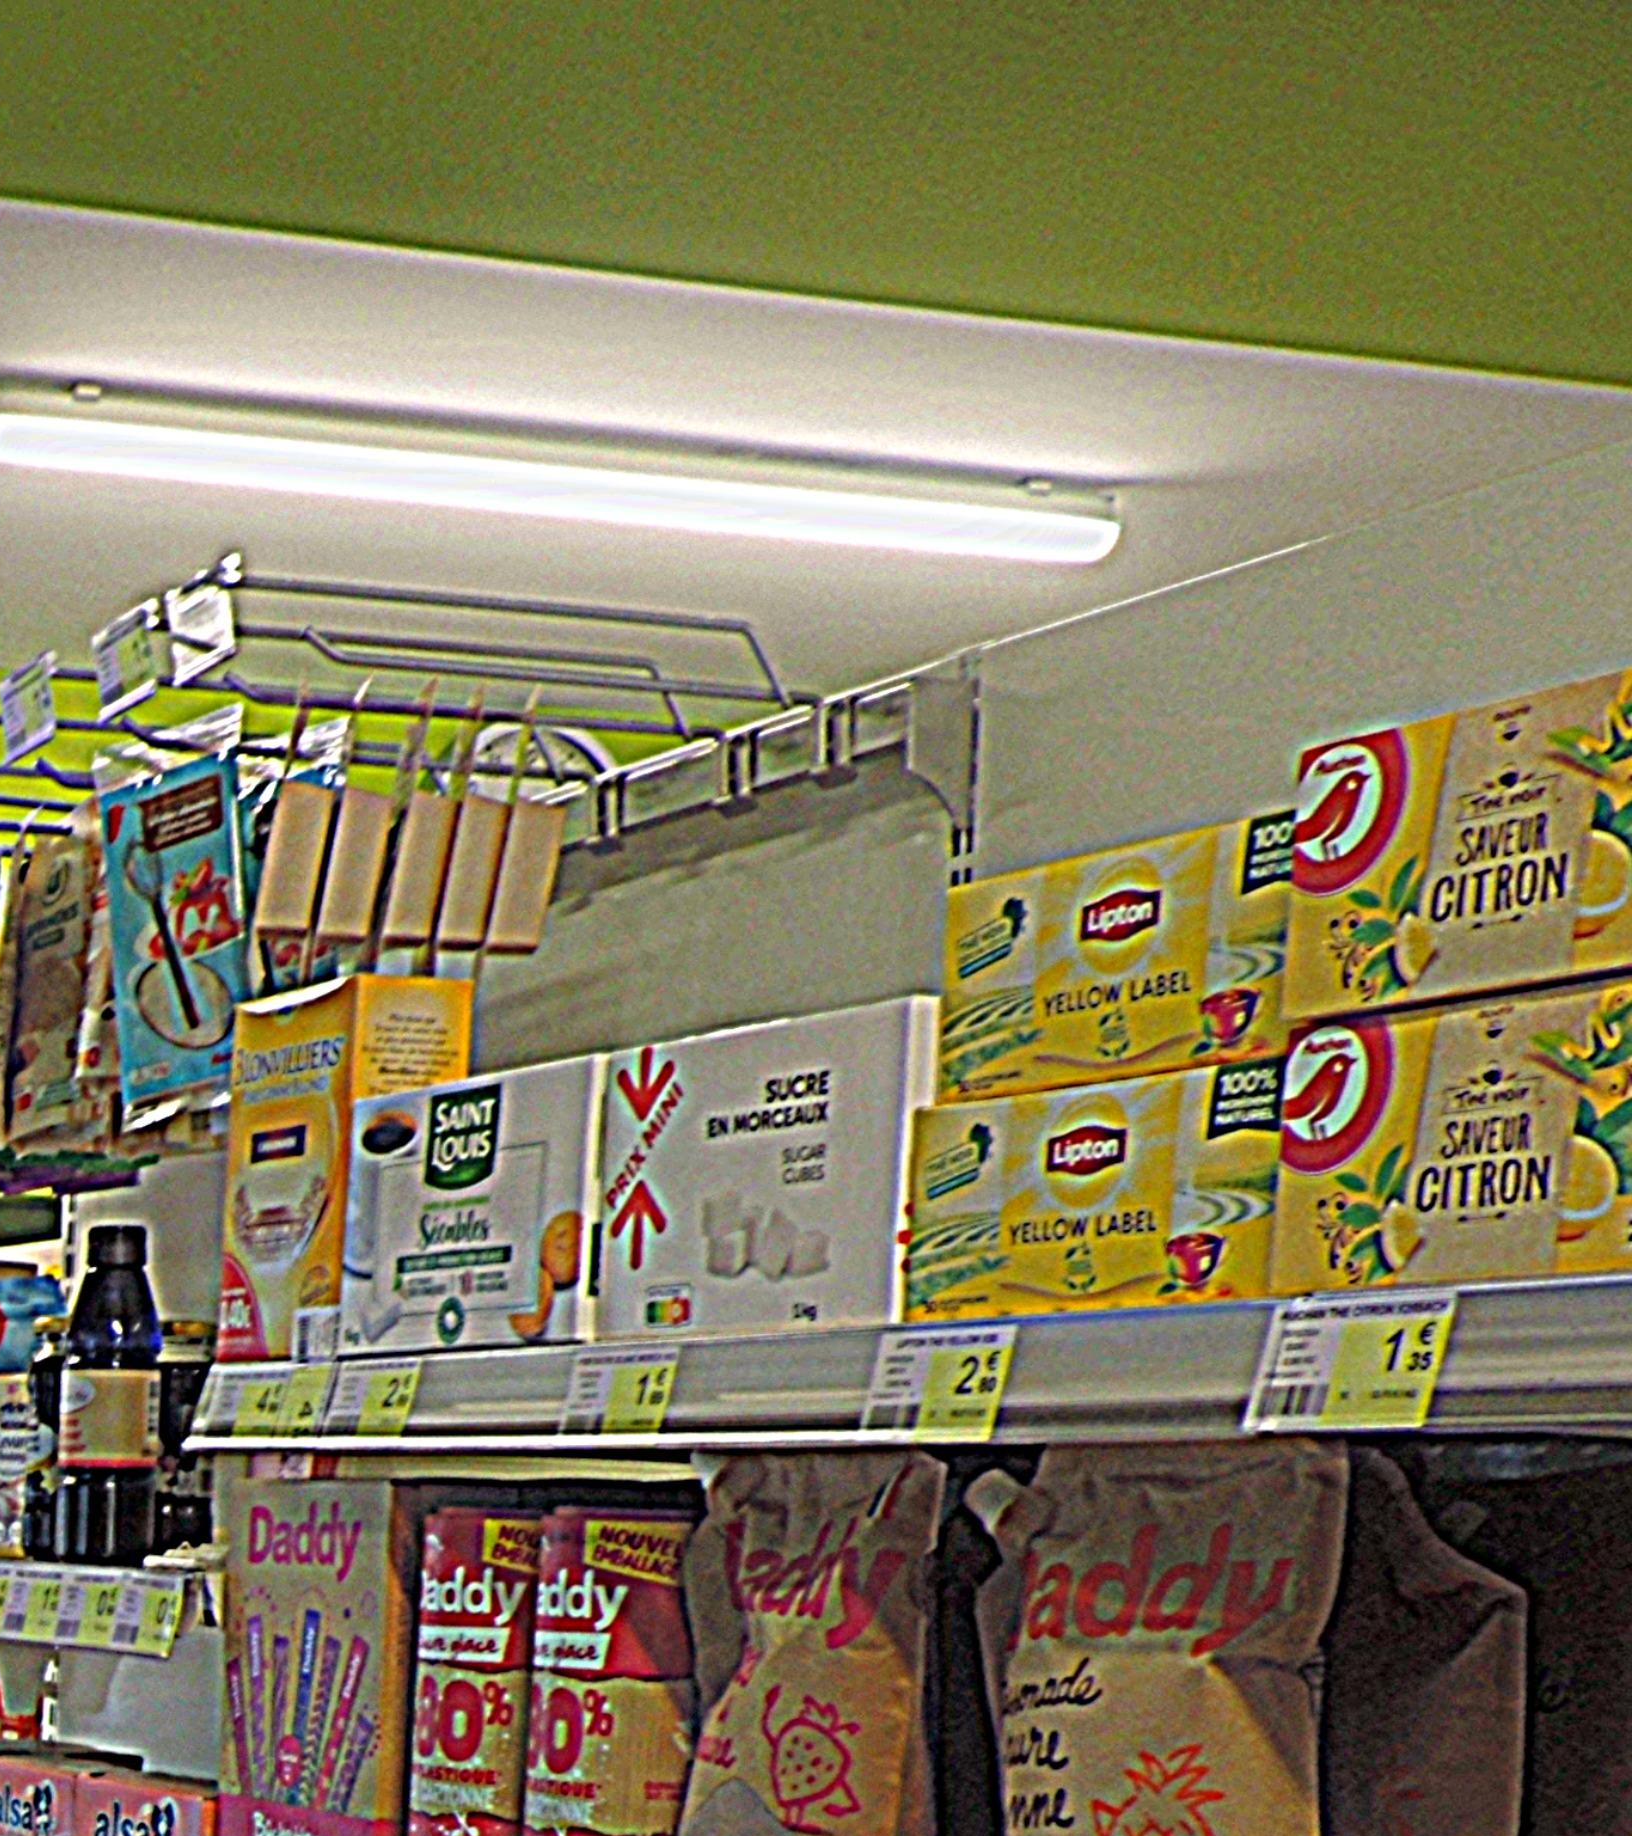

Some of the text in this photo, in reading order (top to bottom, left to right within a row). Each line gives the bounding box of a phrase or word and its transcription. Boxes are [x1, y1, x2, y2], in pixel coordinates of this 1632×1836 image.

[1253, 822, 1293, 848] 100
[1455, 812, 1549, 867] SAVEUR
[1430, 853, 1568, 923] CITRON
[1085, 899, 1155, 933] Lipton
[1043, 970, 1191, 1016] YELLOW LABEL
[764, 1070, 830, 1103] SUCRE
[1220, 1067, 1278, 1095] 100%
[435, 1097, 496, 1134] SAINT
[708, 1103, 829, 1138] EN MORCEAUX
[1441, 1113, 1532, 1159] SAVEUR
[432, 1129, 493, 1171] LOUIS
[605, 1081, 684, 1209] PRIX MINI
[782, 1144, 826, 1163] SUGAR
[1053, 1139, 1120, 1163] Lipton
[1416, 1155, 1553, 1213] CITRON
[1008, 1210, 1157, 1243] YELLOW LABEL
[1384, 1329, 1405, 1371] 1
[1408, 1352, 1432, 1371] 35
[955, 1357, 978, 1396] 2
[248, 1502, 362, 1581] Daddy
[421, 1566, 528, 1627] addy
[1007, 1522, 1294, 1658] addy
[1007, 1727, 1069, 1770] ure
